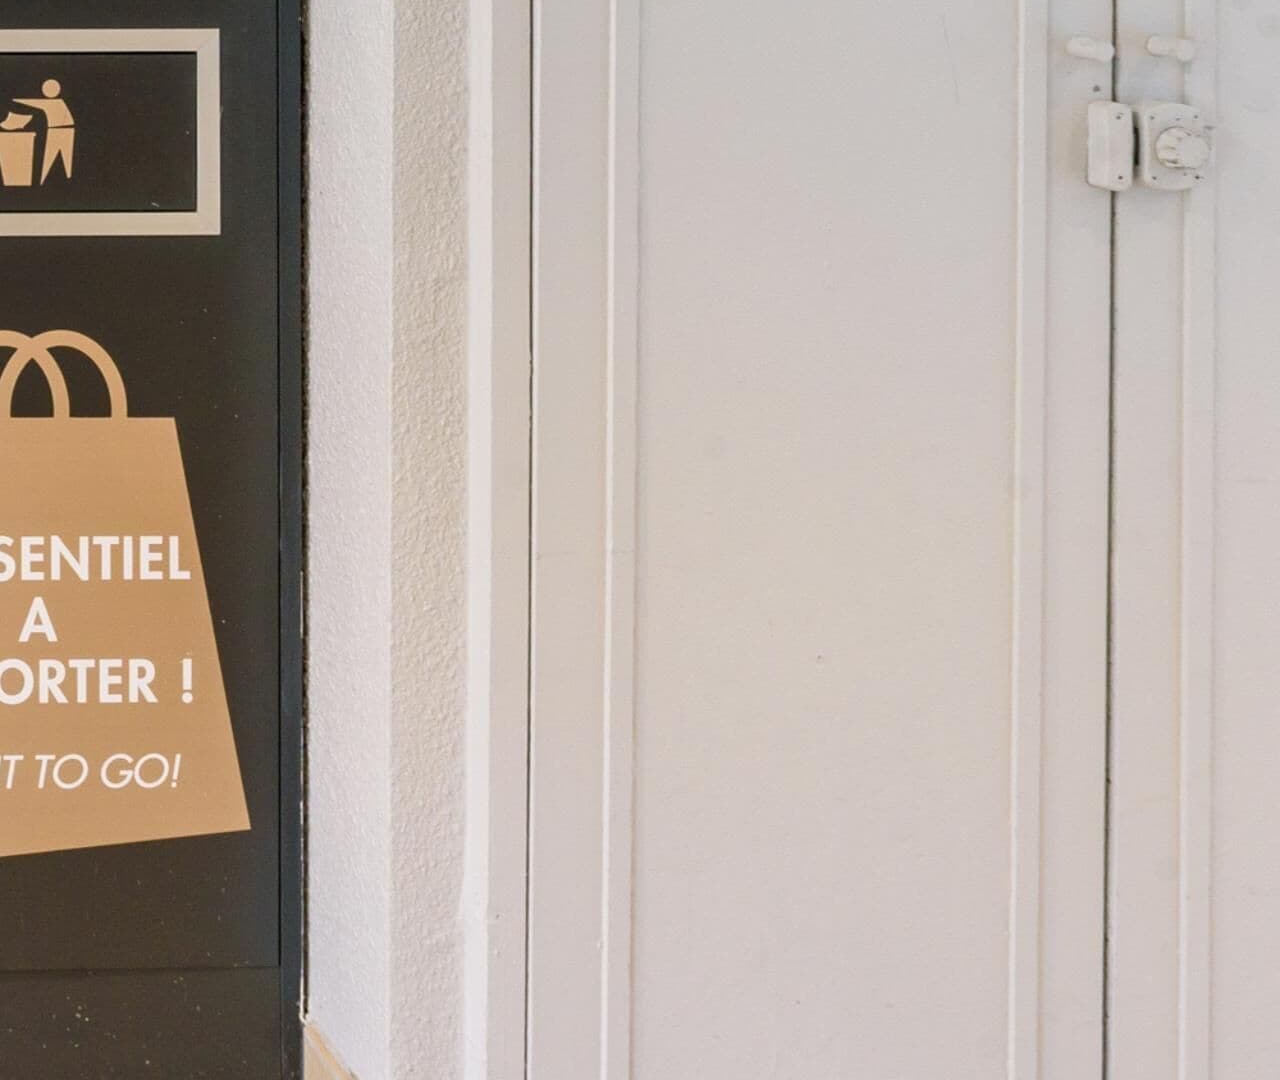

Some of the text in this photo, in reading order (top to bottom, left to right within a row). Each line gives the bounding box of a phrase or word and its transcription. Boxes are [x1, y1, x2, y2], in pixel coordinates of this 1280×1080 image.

[18, 596, 59, 643] A
[35, 753, 89, 790] TO
[99, 753, 183, 790] GO!
